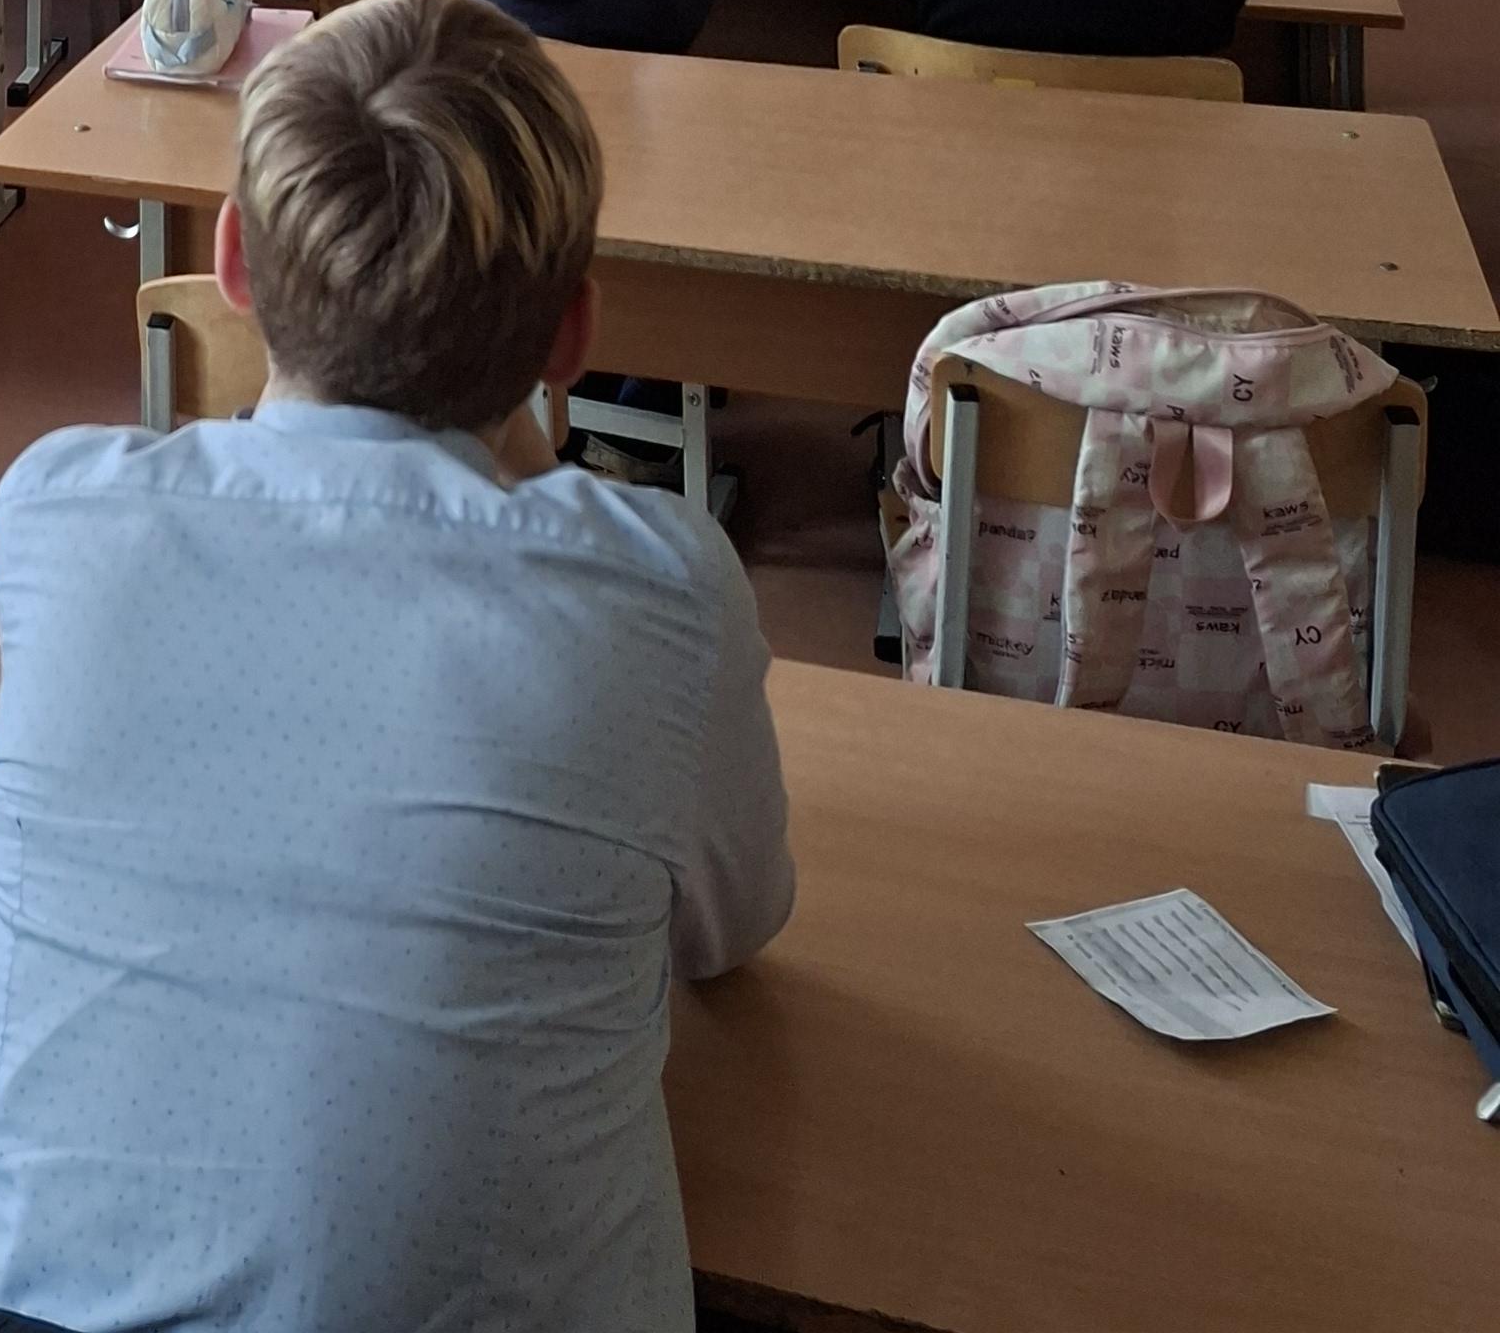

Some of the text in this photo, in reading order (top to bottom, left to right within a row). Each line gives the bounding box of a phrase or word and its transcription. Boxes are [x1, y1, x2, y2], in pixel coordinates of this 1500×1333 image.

[1233, 373, 1255, 403] CY
[1263, 500, 1309, 520] kaws
[1195, 621, 1241, 634] kaws
[1295, 625, 1322, 646] CY
